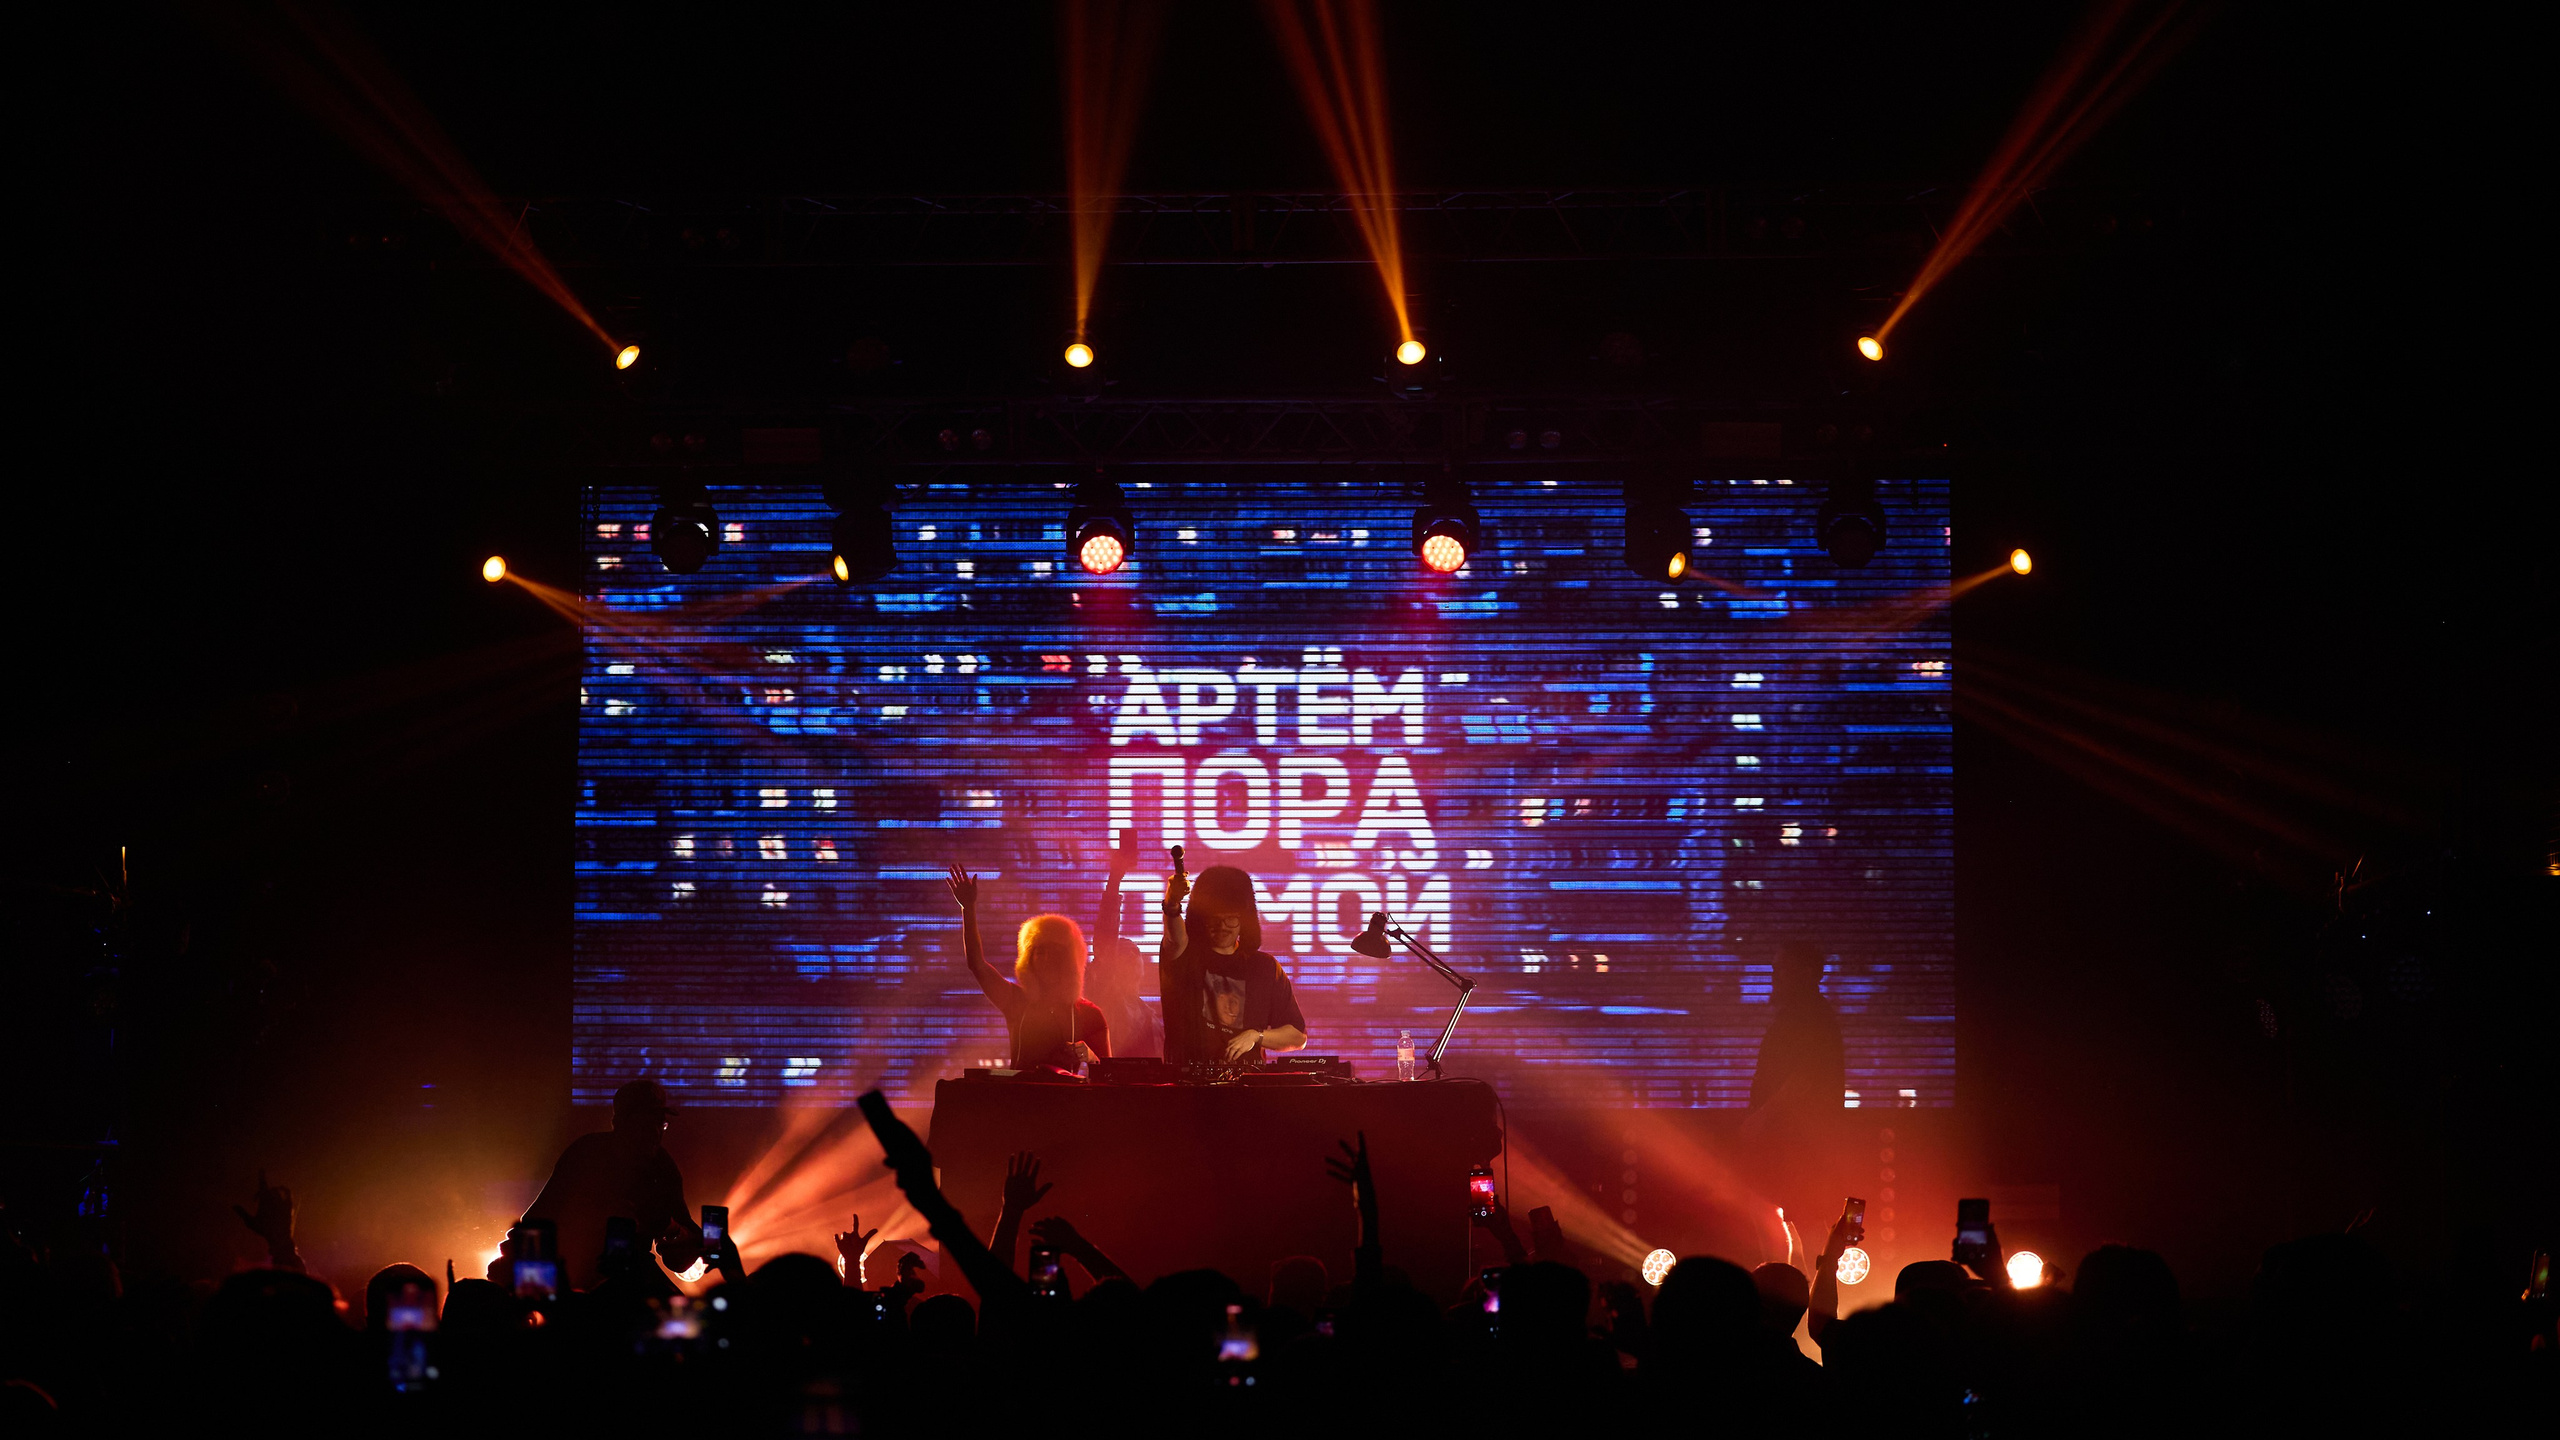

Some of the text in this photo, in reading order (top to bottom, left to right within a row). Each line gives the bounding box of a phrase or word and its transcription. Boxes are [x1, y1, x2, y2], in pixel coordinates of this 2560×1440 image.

[1110, 646, 1425, 746] АРТЁМ
[1108, 756, 1437, 850] ПОРА
[1089, 849, 1451, 964] ДМОЙ
